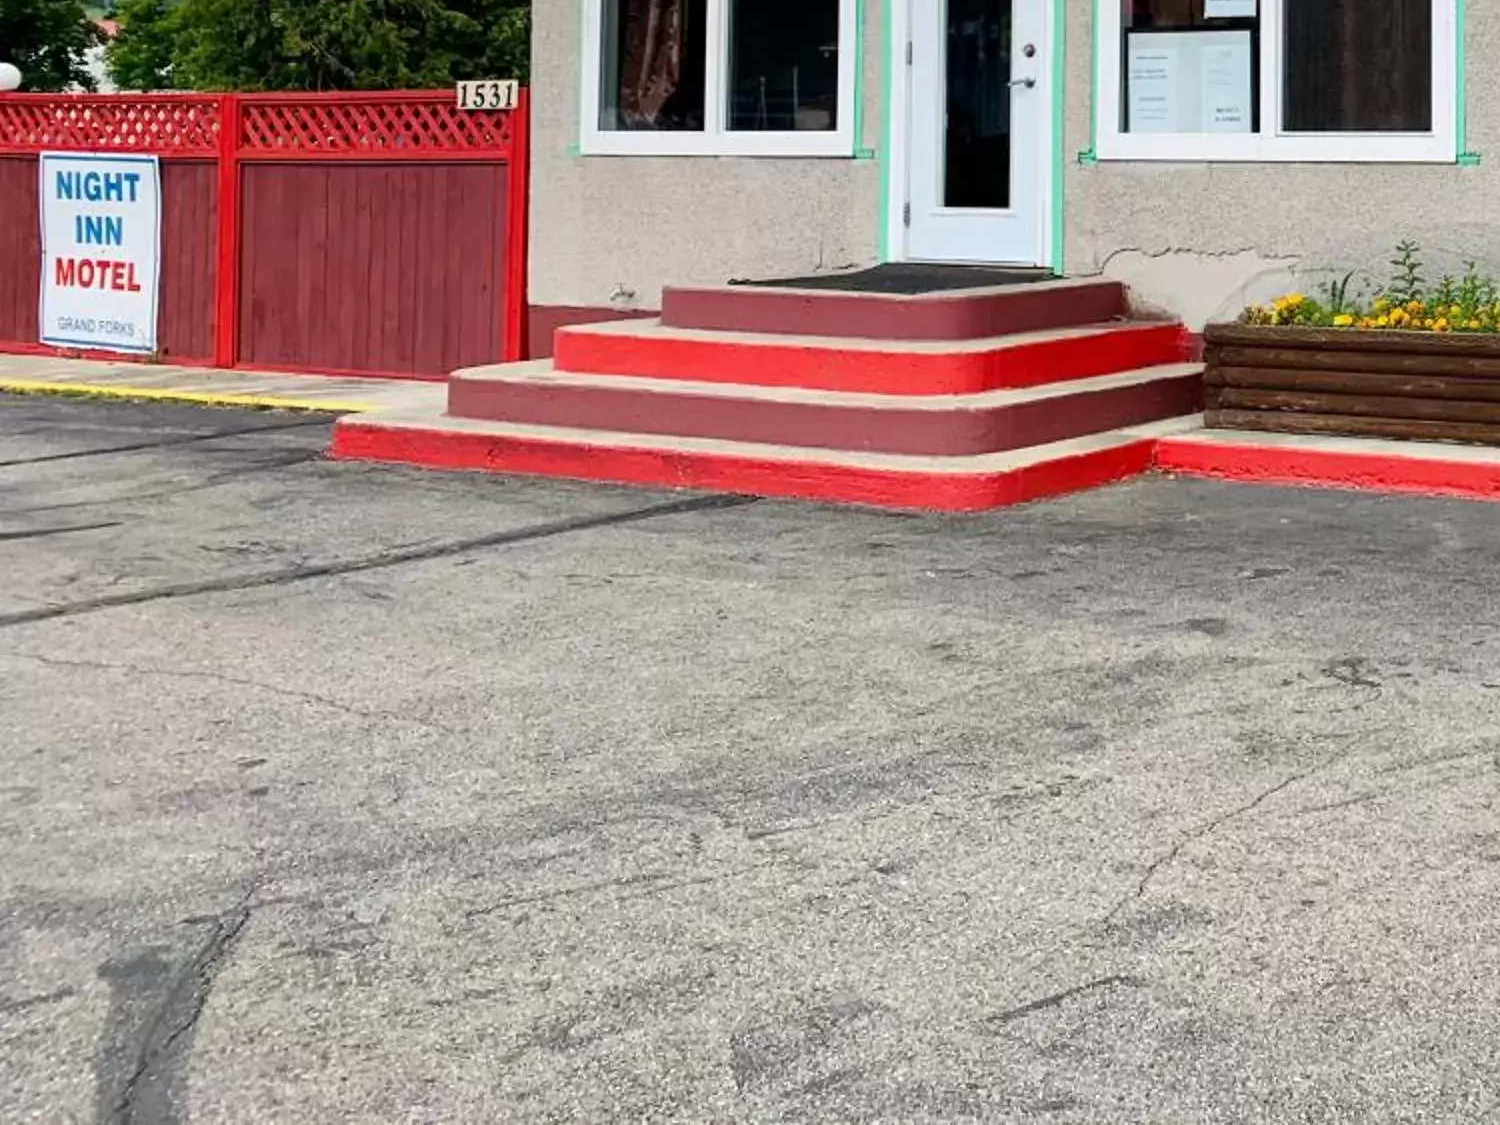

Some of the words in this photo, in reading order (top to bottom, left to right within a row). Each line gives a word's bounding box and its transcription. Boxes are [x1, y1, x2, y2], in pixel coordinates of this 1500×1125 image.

[460, 82, 513, 108] 1531
[55, 170, 140, 202] NIGHT
[75, 214, 123, 246] INN
[55, 256, 141, 293] MOTEL
[57, 316, 96, 334] GRAND
[98, 320, 135, 338] FORKS
